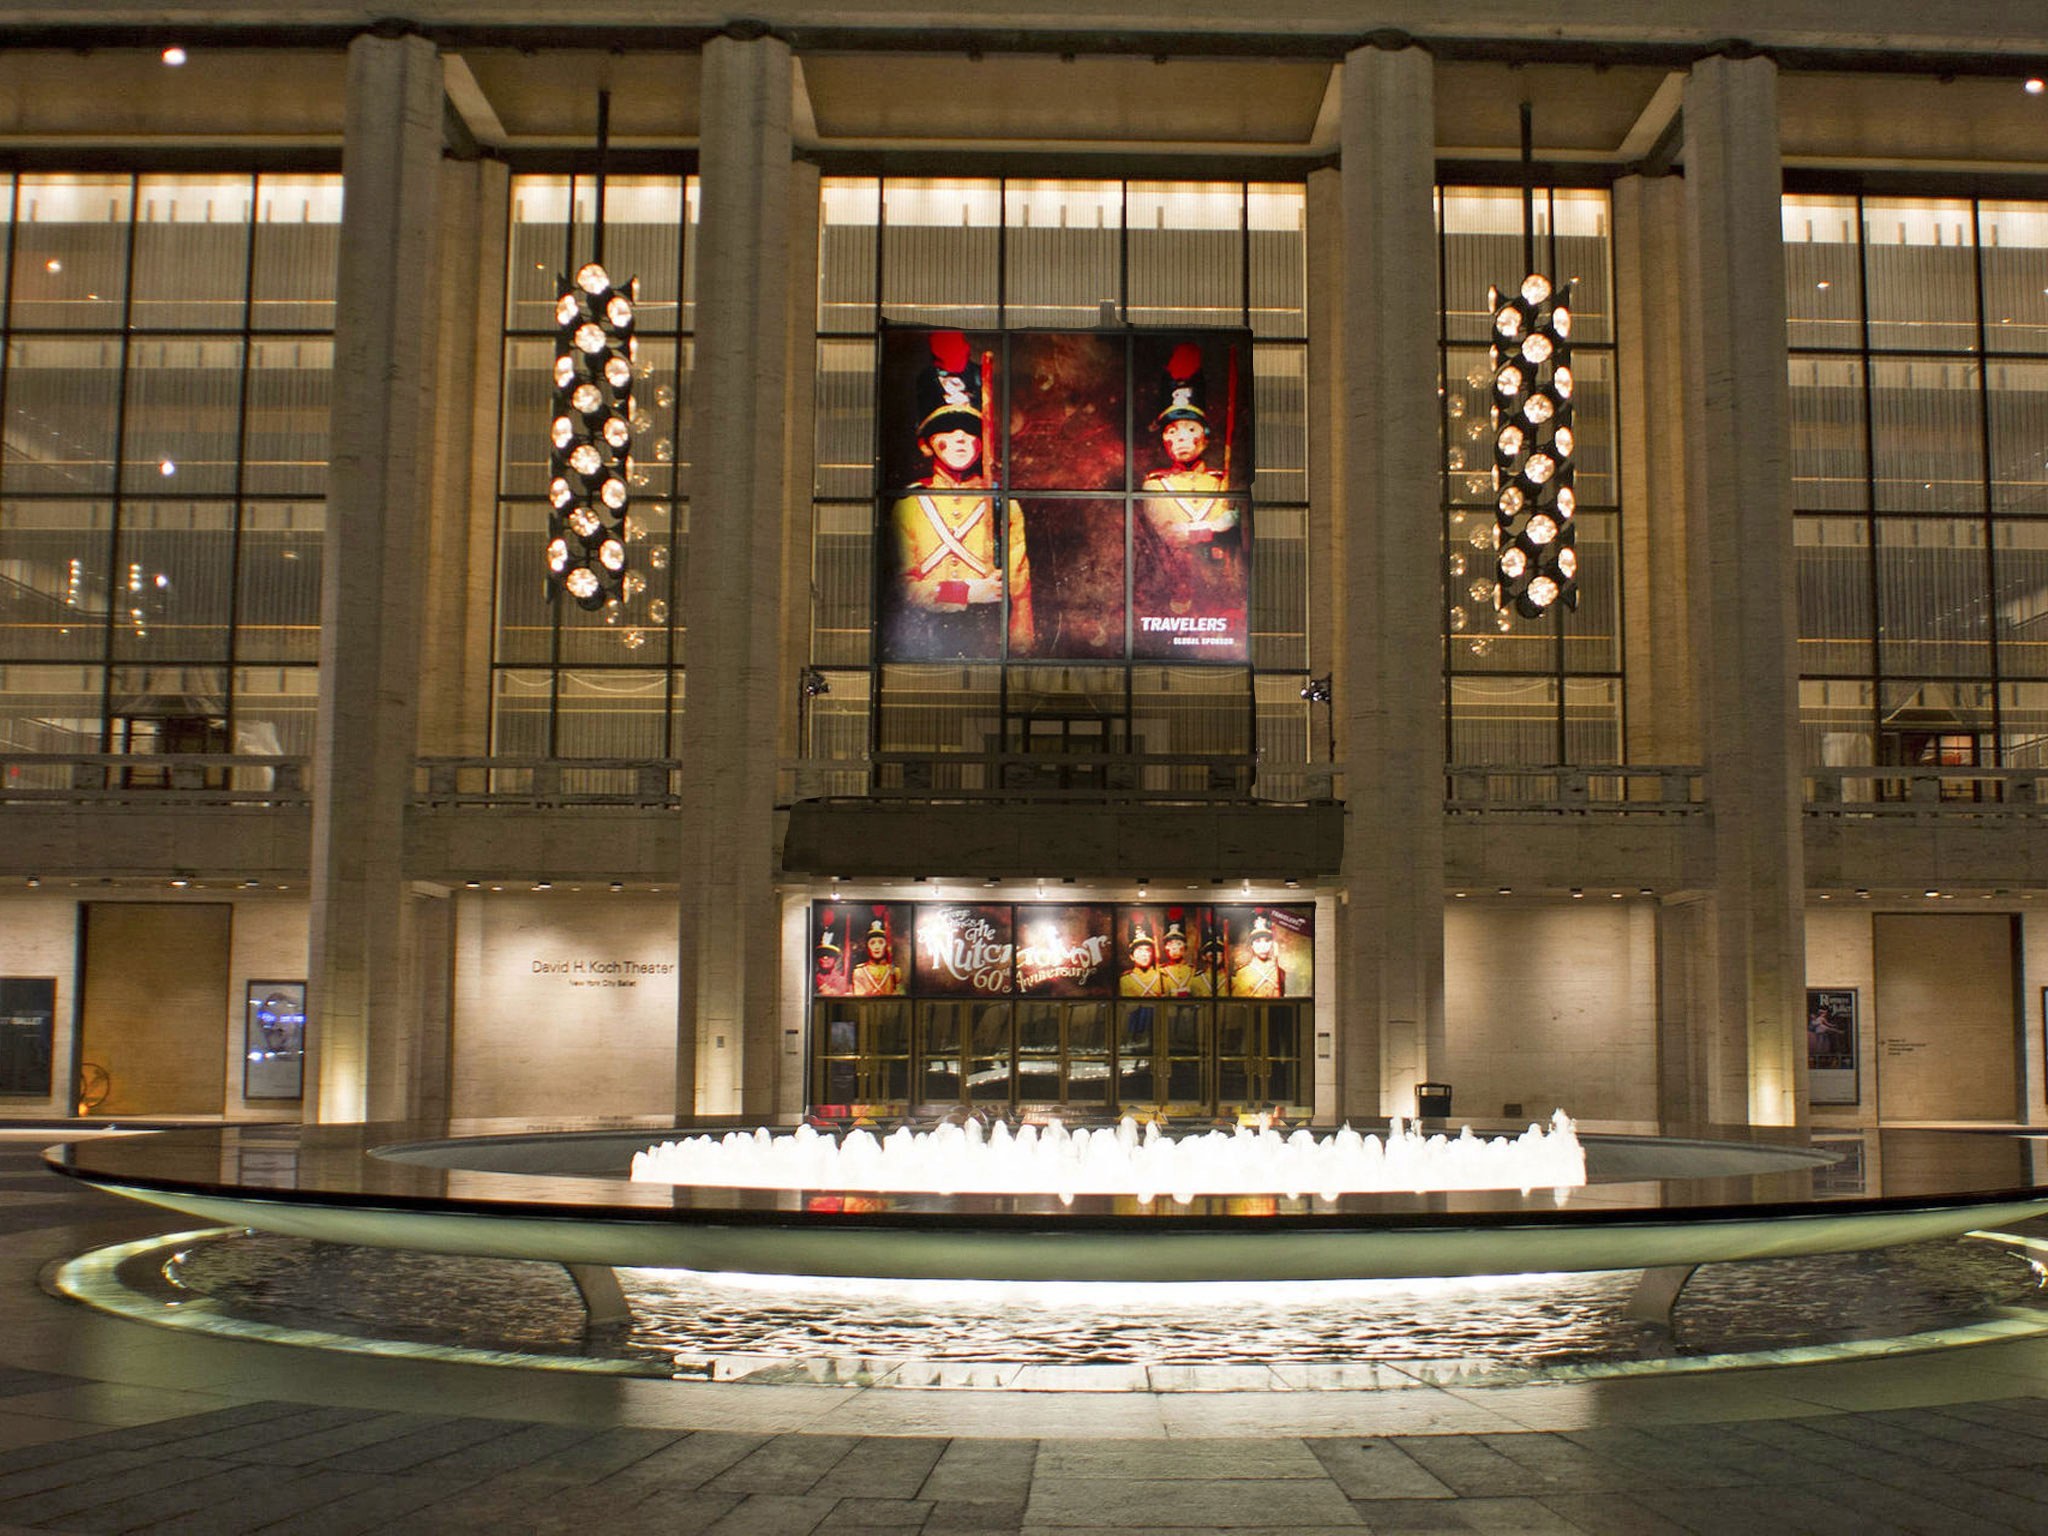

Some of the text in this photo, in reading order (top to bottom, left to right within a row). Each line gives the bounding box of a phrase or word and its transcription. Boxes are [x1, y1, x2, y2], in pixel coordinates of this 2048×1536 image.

[1141, 617, 1227, 632] TRAVELERS
[532, 960, 569, 974] David
[589, 960, 621, 974] Koch
[623, 960, 675, 974] Theater
